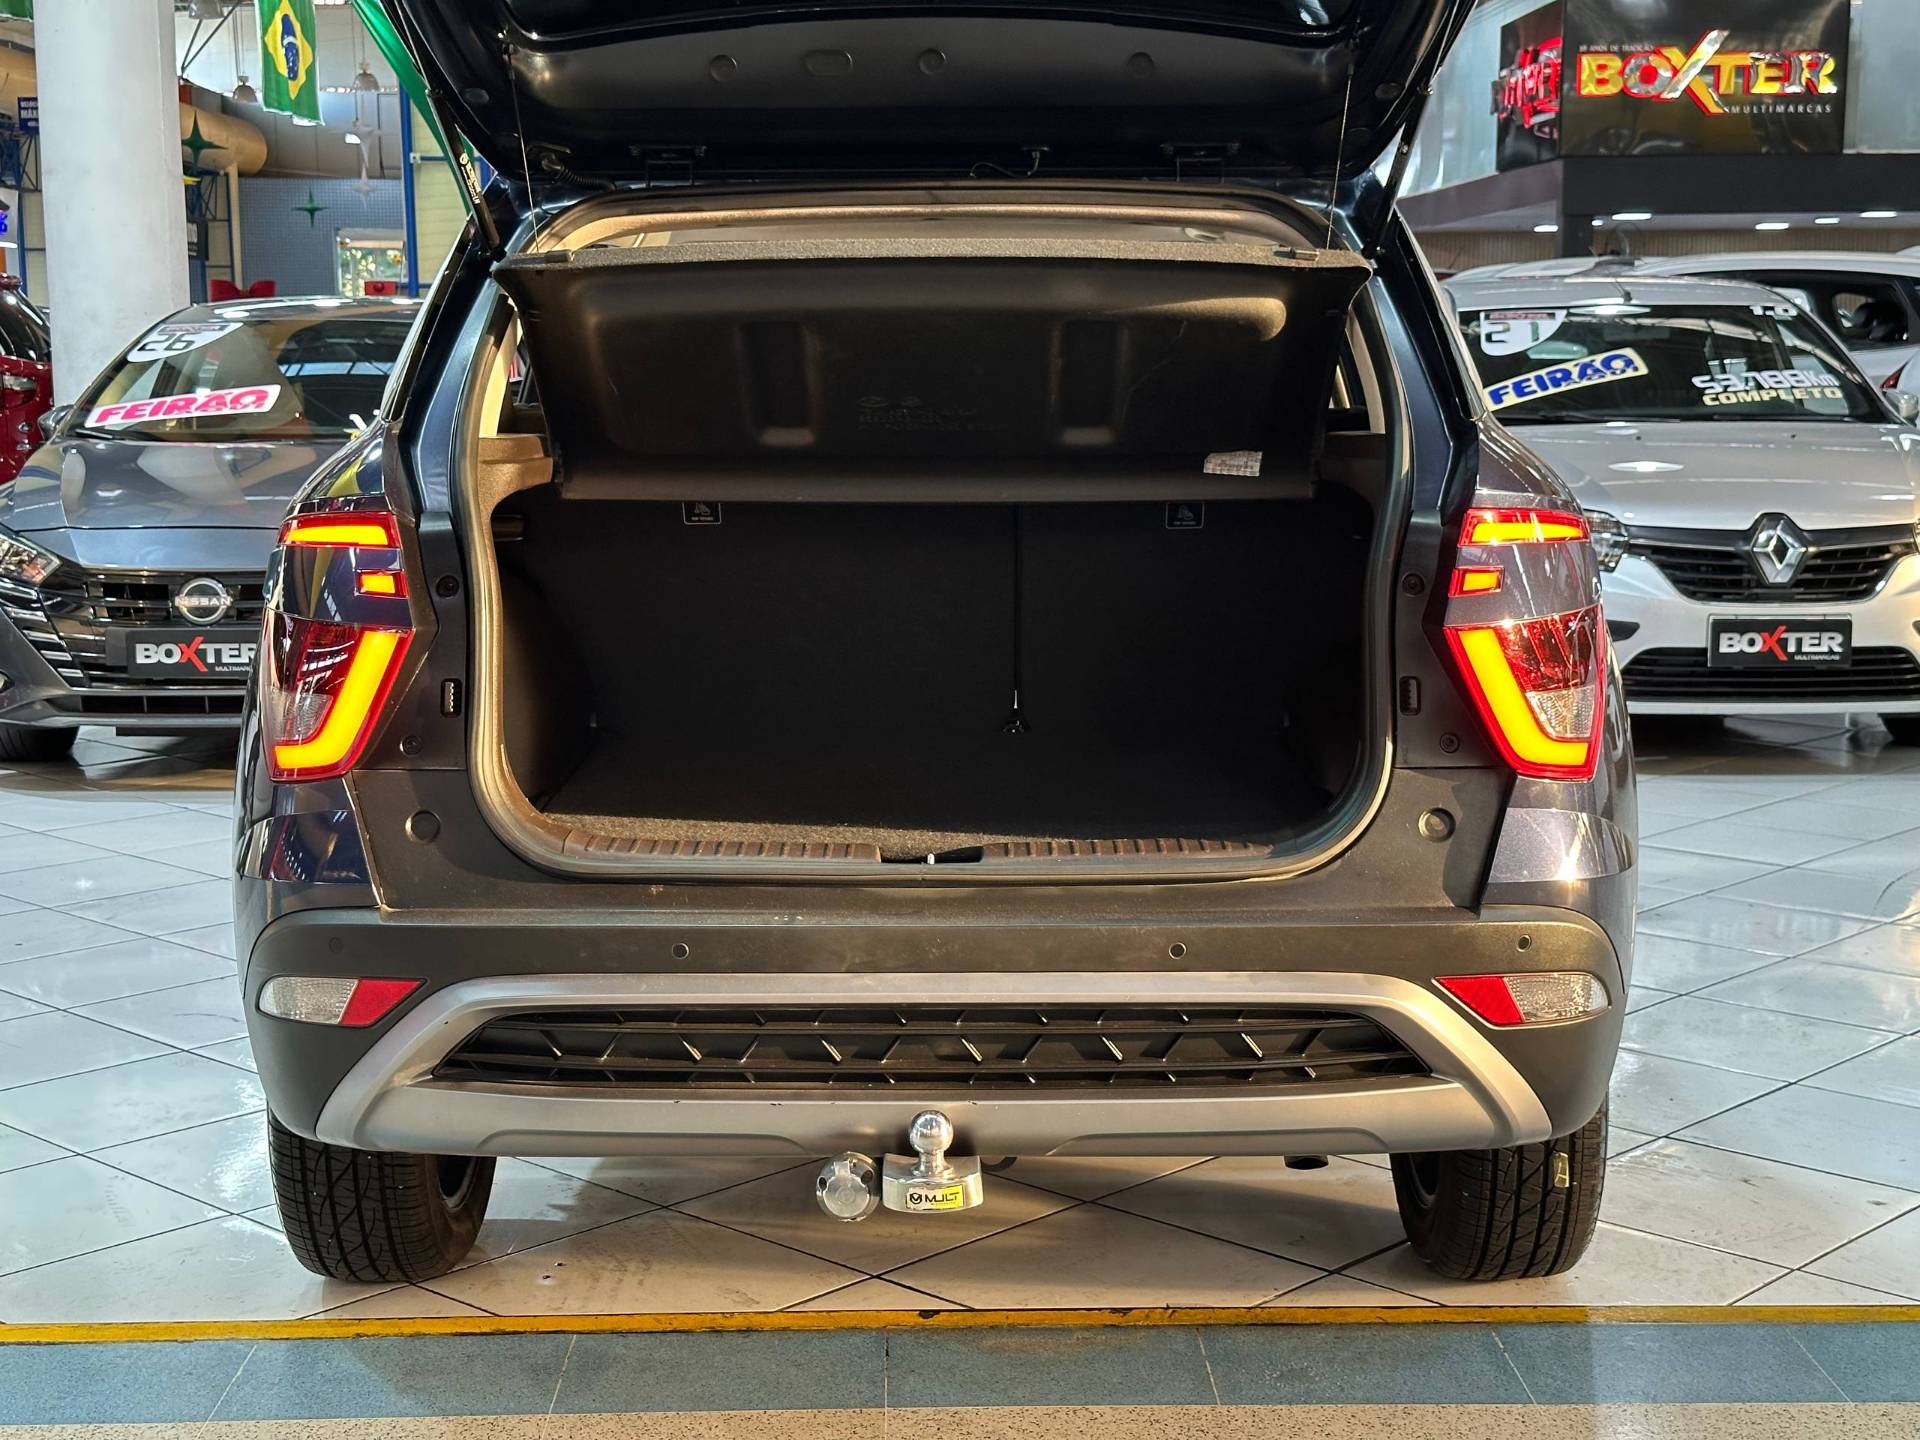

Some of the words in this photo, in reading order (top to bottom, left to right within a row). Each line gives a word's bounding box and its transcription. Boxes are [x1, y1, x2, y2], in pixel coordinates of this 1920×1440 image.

[1574, 28, 1839, 115] BOXTER
[1727, 104, 1833, 114] MULTIMARCAS
[136, 333, 195, 352] 26
[1485, 321, 1539, 344] 21
[1485, 353, 1634, 406] FEIRÃO
[94, 389, 268, 424] FEIRÃO
[1702, 387, 1844, 406] COMPLETO
[175, 596, 232, 607] NISSAN
[1718, 624, 1844, 662] BOXTER
